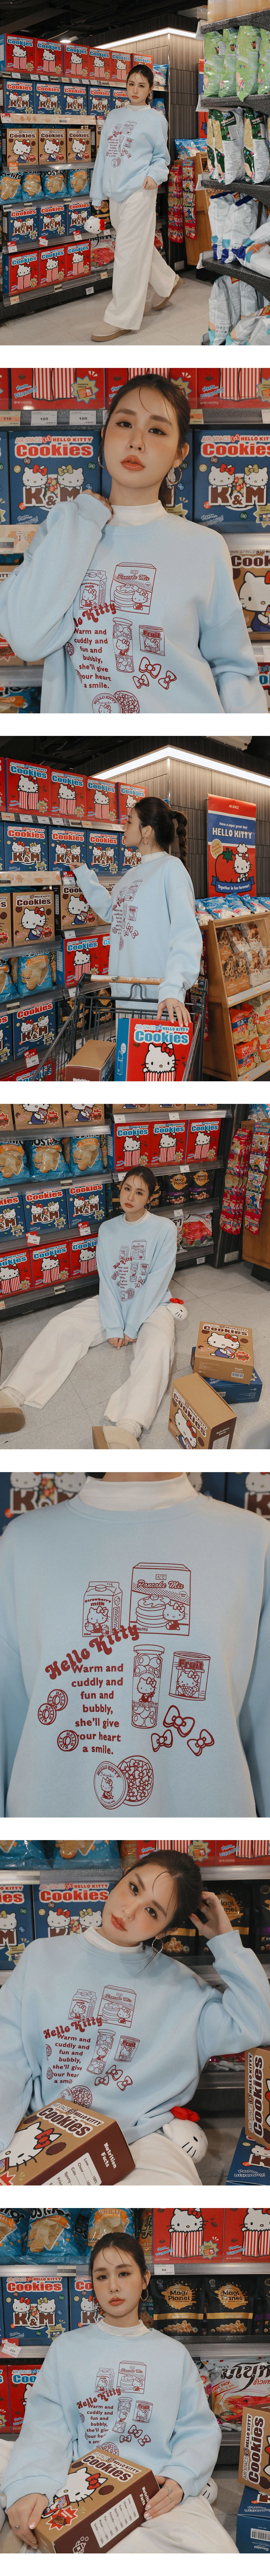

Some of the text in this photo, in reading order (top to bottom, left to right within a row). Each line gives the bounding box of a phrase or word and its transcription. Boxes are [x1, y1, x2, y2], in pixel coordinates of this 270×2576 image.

[14, 386, 38, 398] DELICIOUS!
[16, 444, 92, 457] Cookies
[82, 603, 117, 622] Kitty
[83, 655, 102, 663] bubbly,
[11, 766, 47, 778] Cookies
[8, 830, 44, 839] Cookies
[212, 827, 252, 839] HELLO KITTY
[135, 1031, 189, 1043] Cookies
[204, 1326, 248, 1336] Cookies
[137, 1579, 184, 1589] Pancake Mix
[45, 1625, 139, 1680] Hello Kitty
[71, 1664, 103, 1673] Warm
[178, 1659, 204, 1670] Fruit
[71, 1677, 123, 1688] cuddly and
[80, 1691, 114, 1699] fun and
[83, 1704, 113, 1715] bubbly,
[75, 1718, 119, 1729] she'll give
[99, 1732, 121, 1742] heart
[92, 1745, 113, 1754] smile.
[97, 1765, 121, 1778] HELLO KITTY
[41, 1891, 108, 1901] Cookies
[44, 2017, 102, 2039] Hello Kitty
[254, 2058, 263, 2136] Cookies
[38, 2107, 90, 2136] Cookies
[74, 2111, 88, 2119] HELLO
[86, 2117, 102, 2125] KITTY
[101, 2153, 109, 2167] Facts
[103, 2142, 117, 2169] Nutrition
[155, 2247, 174, 2256] DELICIOUS!
[77, 2388, 121, 2409] Hello Kitty
[82, 2455, 131, 2481] Cookies
